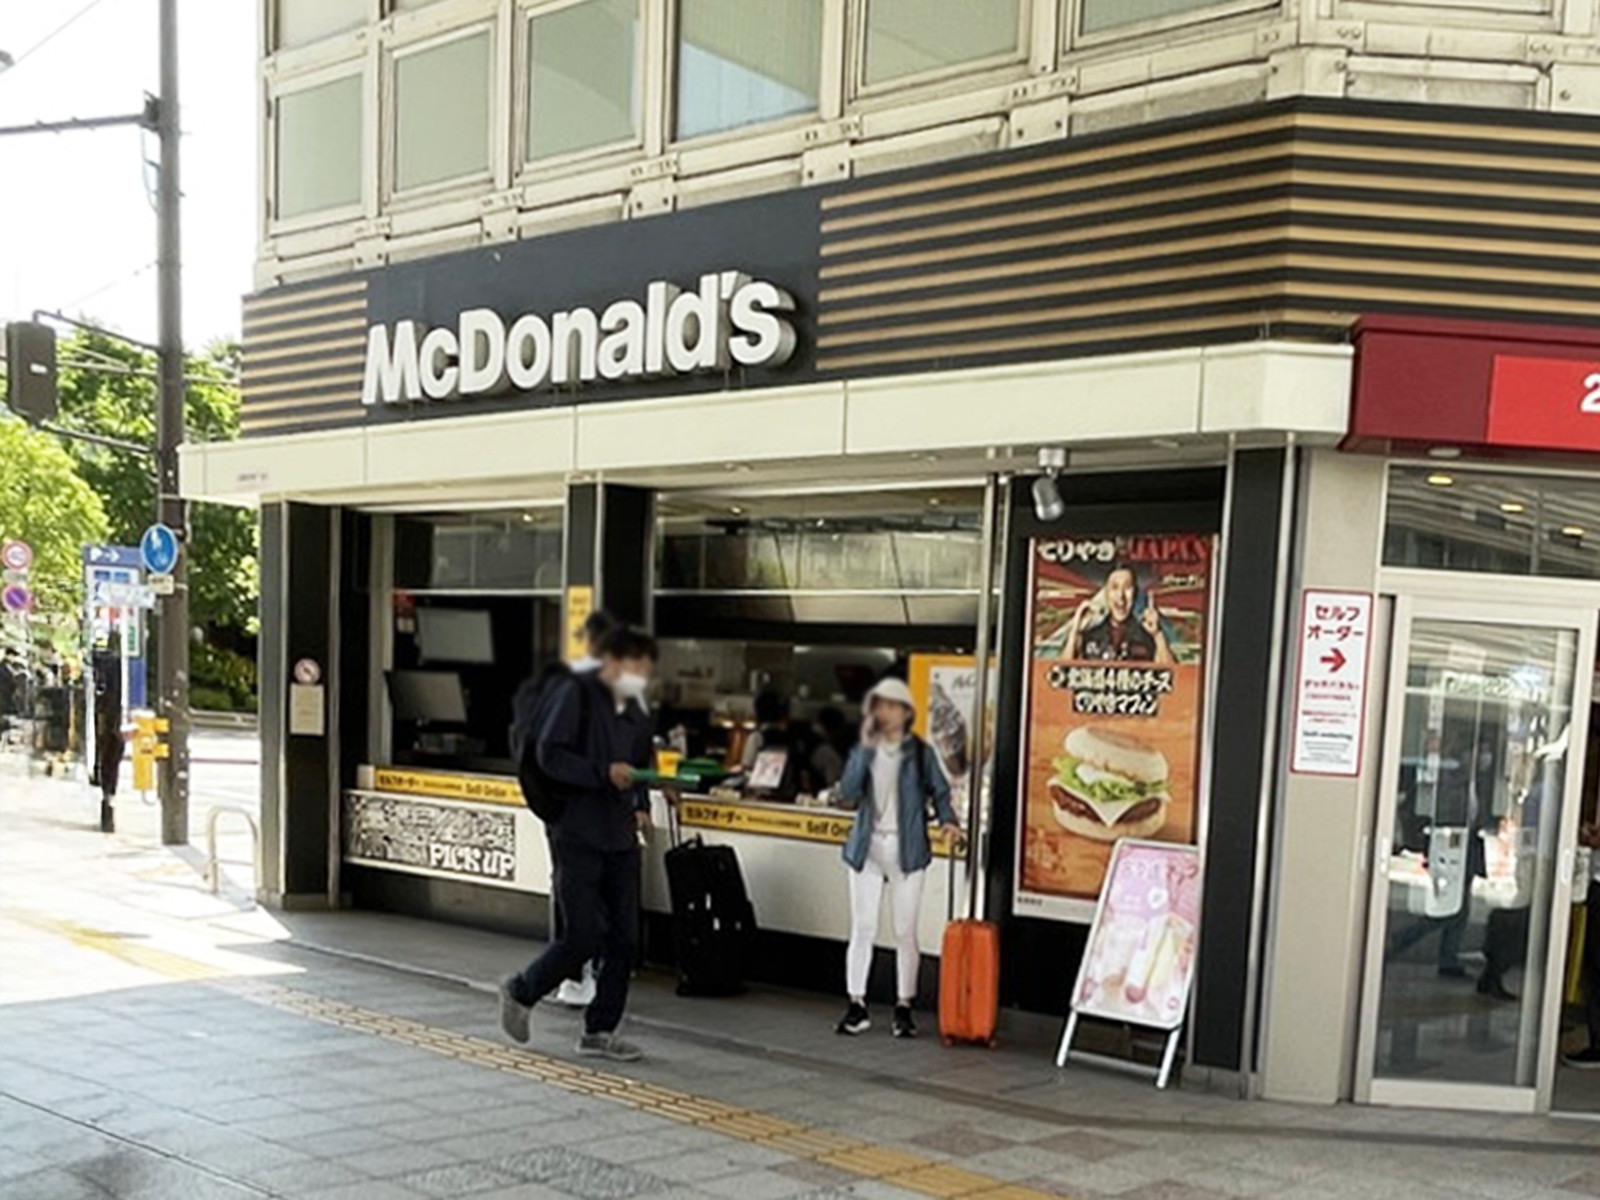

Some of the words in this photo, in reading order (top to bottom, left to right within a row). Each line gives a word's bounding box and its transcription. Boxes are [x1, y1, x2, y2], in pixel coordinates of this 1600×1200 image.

[361, 270, 788, 405] McDonald's
[1315, 603, 1361, 622] セルフ
[1306, 624, 1365, 642] オーダー
[806, 819, 829, 835] Self
[429, 842, 481, 874] PICK
[482, 848, 516, 878] UP
